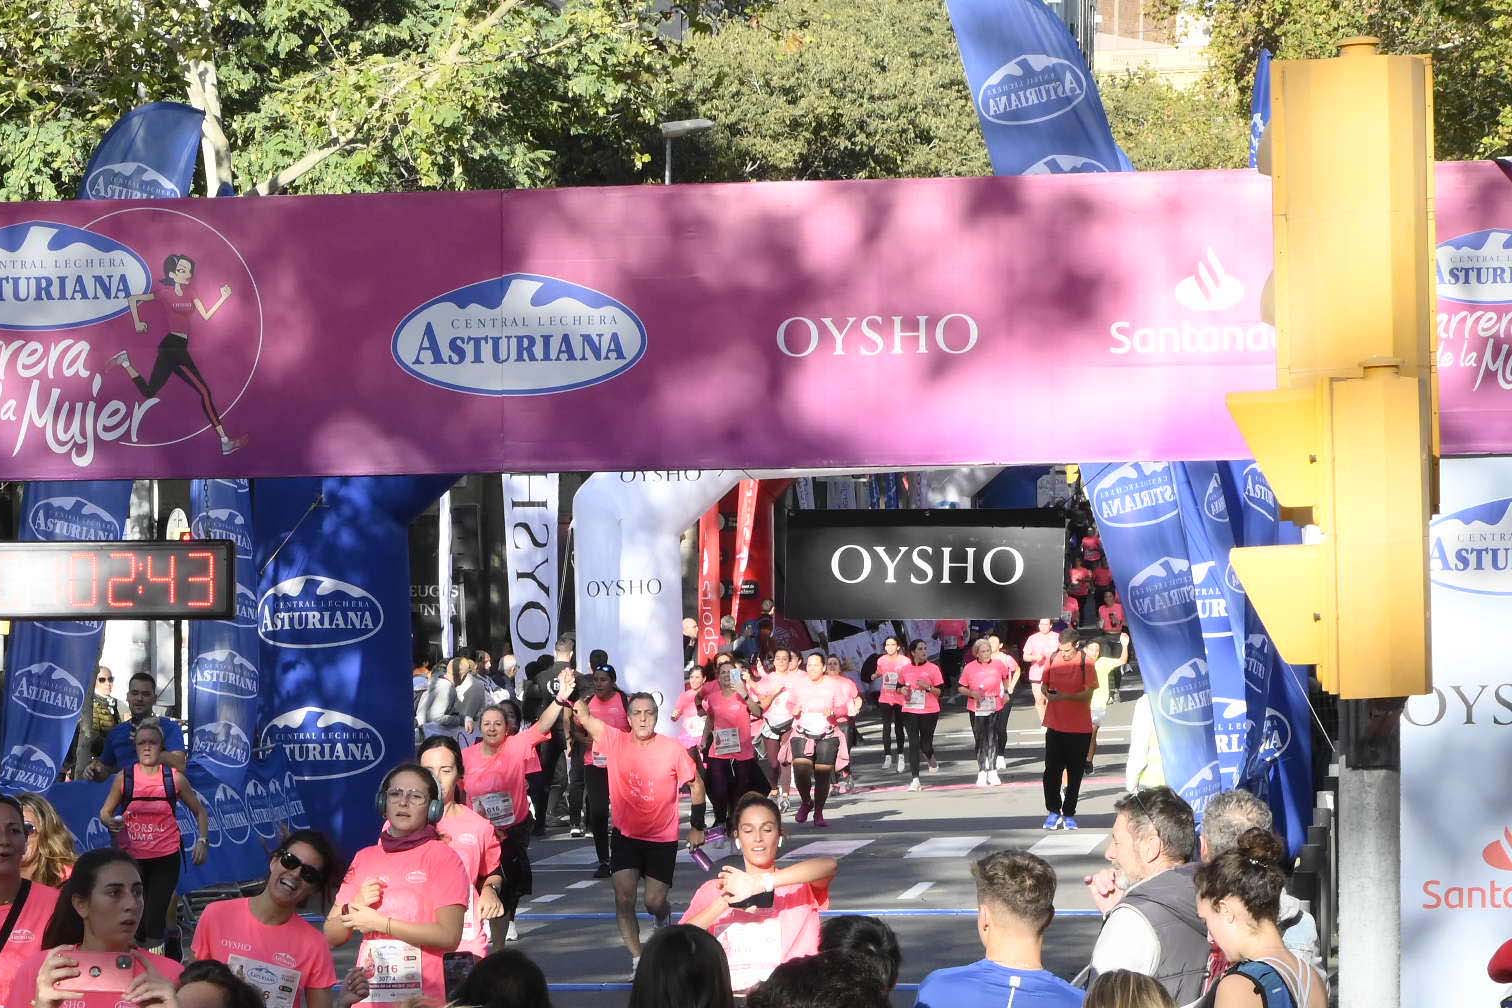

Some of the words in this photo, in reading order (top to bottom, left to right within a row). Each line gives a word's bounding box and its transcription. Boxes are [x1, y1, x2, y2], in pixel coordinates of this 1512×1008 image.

[54, 257, 127, 268] LECHERA
[451, 317, 528, 329] CENTRAL
[538, 314, 618, 326] LECHERA
[412, 321, 626, 365] ASTURIANA
[776, 313, 979, 357] OYSHO
[12, 372, 160, 467] Mujer
[831, 544, 1024, 585] OYSHO
[587, 578, 662, 598] OYSHO
[275, 600, 316, 608] CENTRAL
[261, 604, 374, 633] ASTURIANA
[194, 668, 257, 692] ASTURIANA
[221, 938, 252, 951] OYSHO
[377, 964, 398, 975] 016
